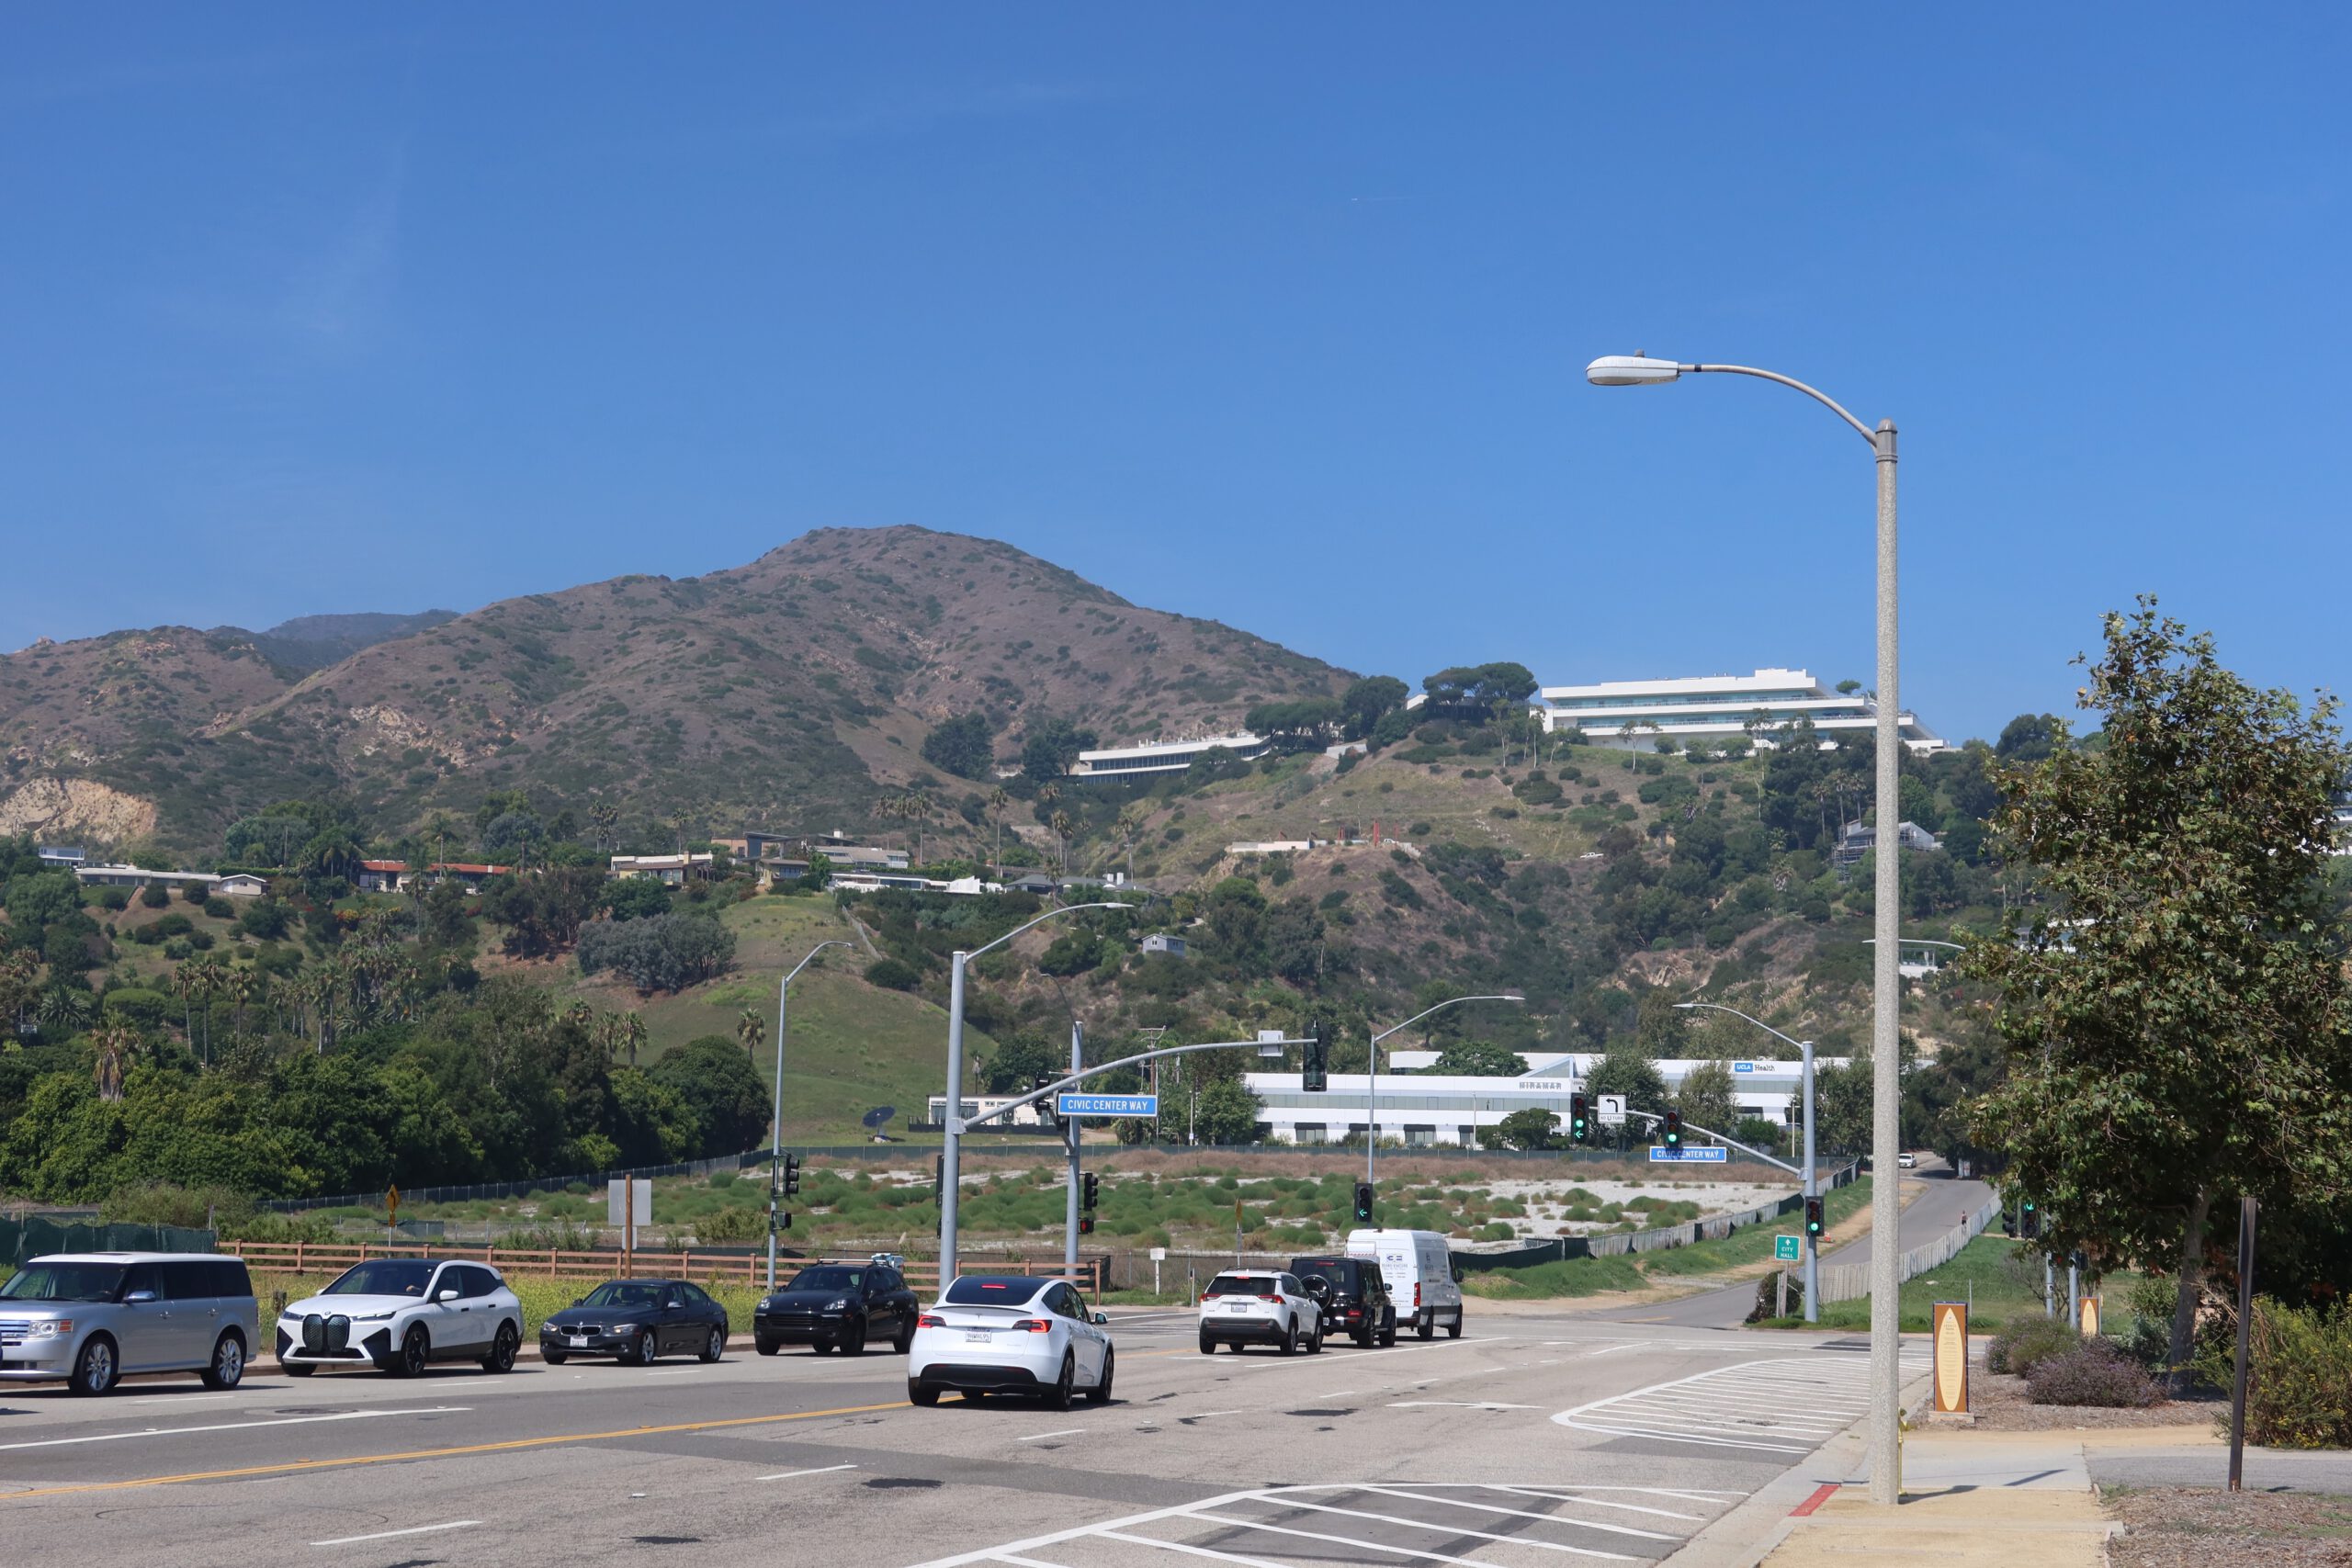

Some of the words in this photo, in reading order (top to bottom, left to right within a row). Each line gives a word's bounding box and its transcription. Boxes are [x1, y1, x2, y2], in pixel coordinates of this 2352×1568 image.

[1754, 1064, 1775, 1072] Health
[1519, 1081, 1562, 1091] MIRAMAR
[1068, 1100, 1091, 1110] CIVIC
[1093, 1100, 1127, 1111] CENTER
[1129, 1100, 1148, 1110] WAY
[1657, 1150, 1674, 1158] CIVIC
[1677, 1150, 1703, 1158] CENTER
[1704, 1150, 1719, 1158] WAY
